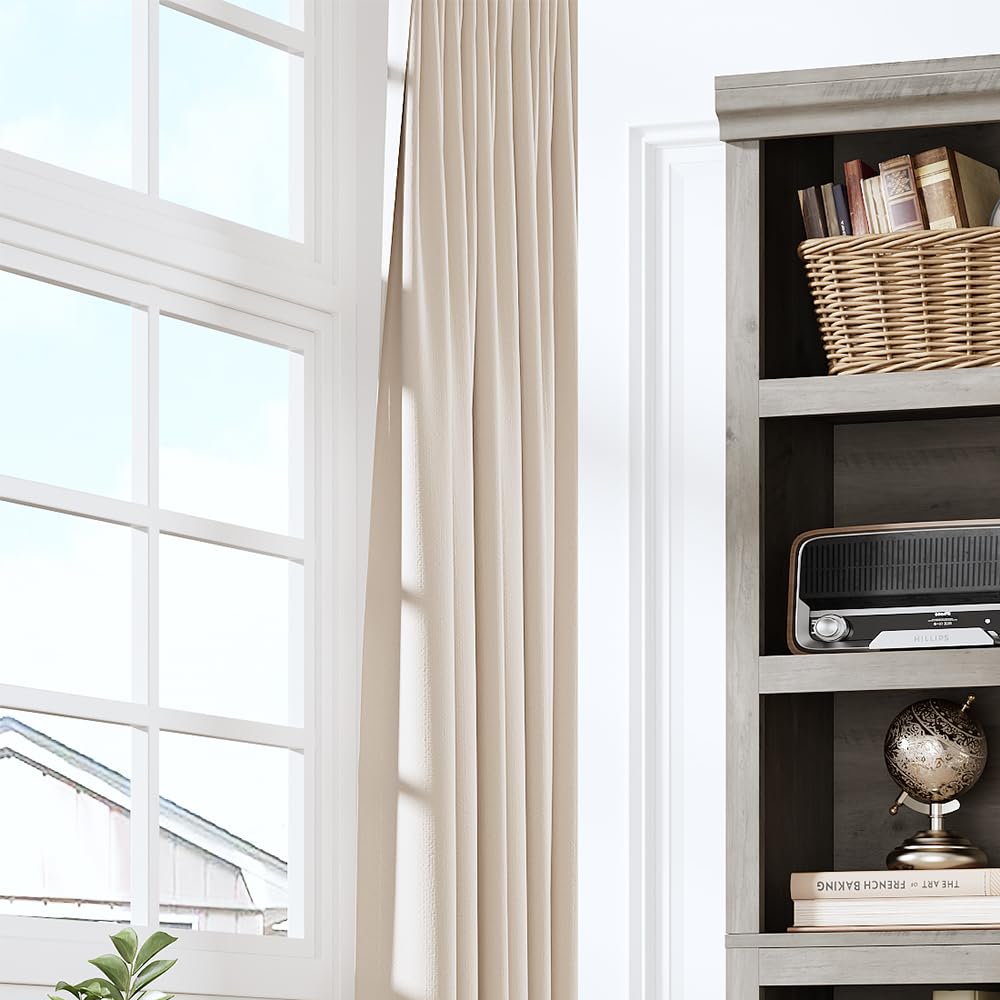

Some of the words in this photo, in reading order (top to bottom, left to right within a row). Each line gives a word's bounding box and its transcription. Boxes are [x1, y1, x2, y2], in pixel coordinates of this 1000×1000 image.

[816, 880, 861, 892] BAKING
[863, 880, 906, 890] FRENCH
[922, 880, 940, 889] ART
[941, 880, 960, 889] THE
